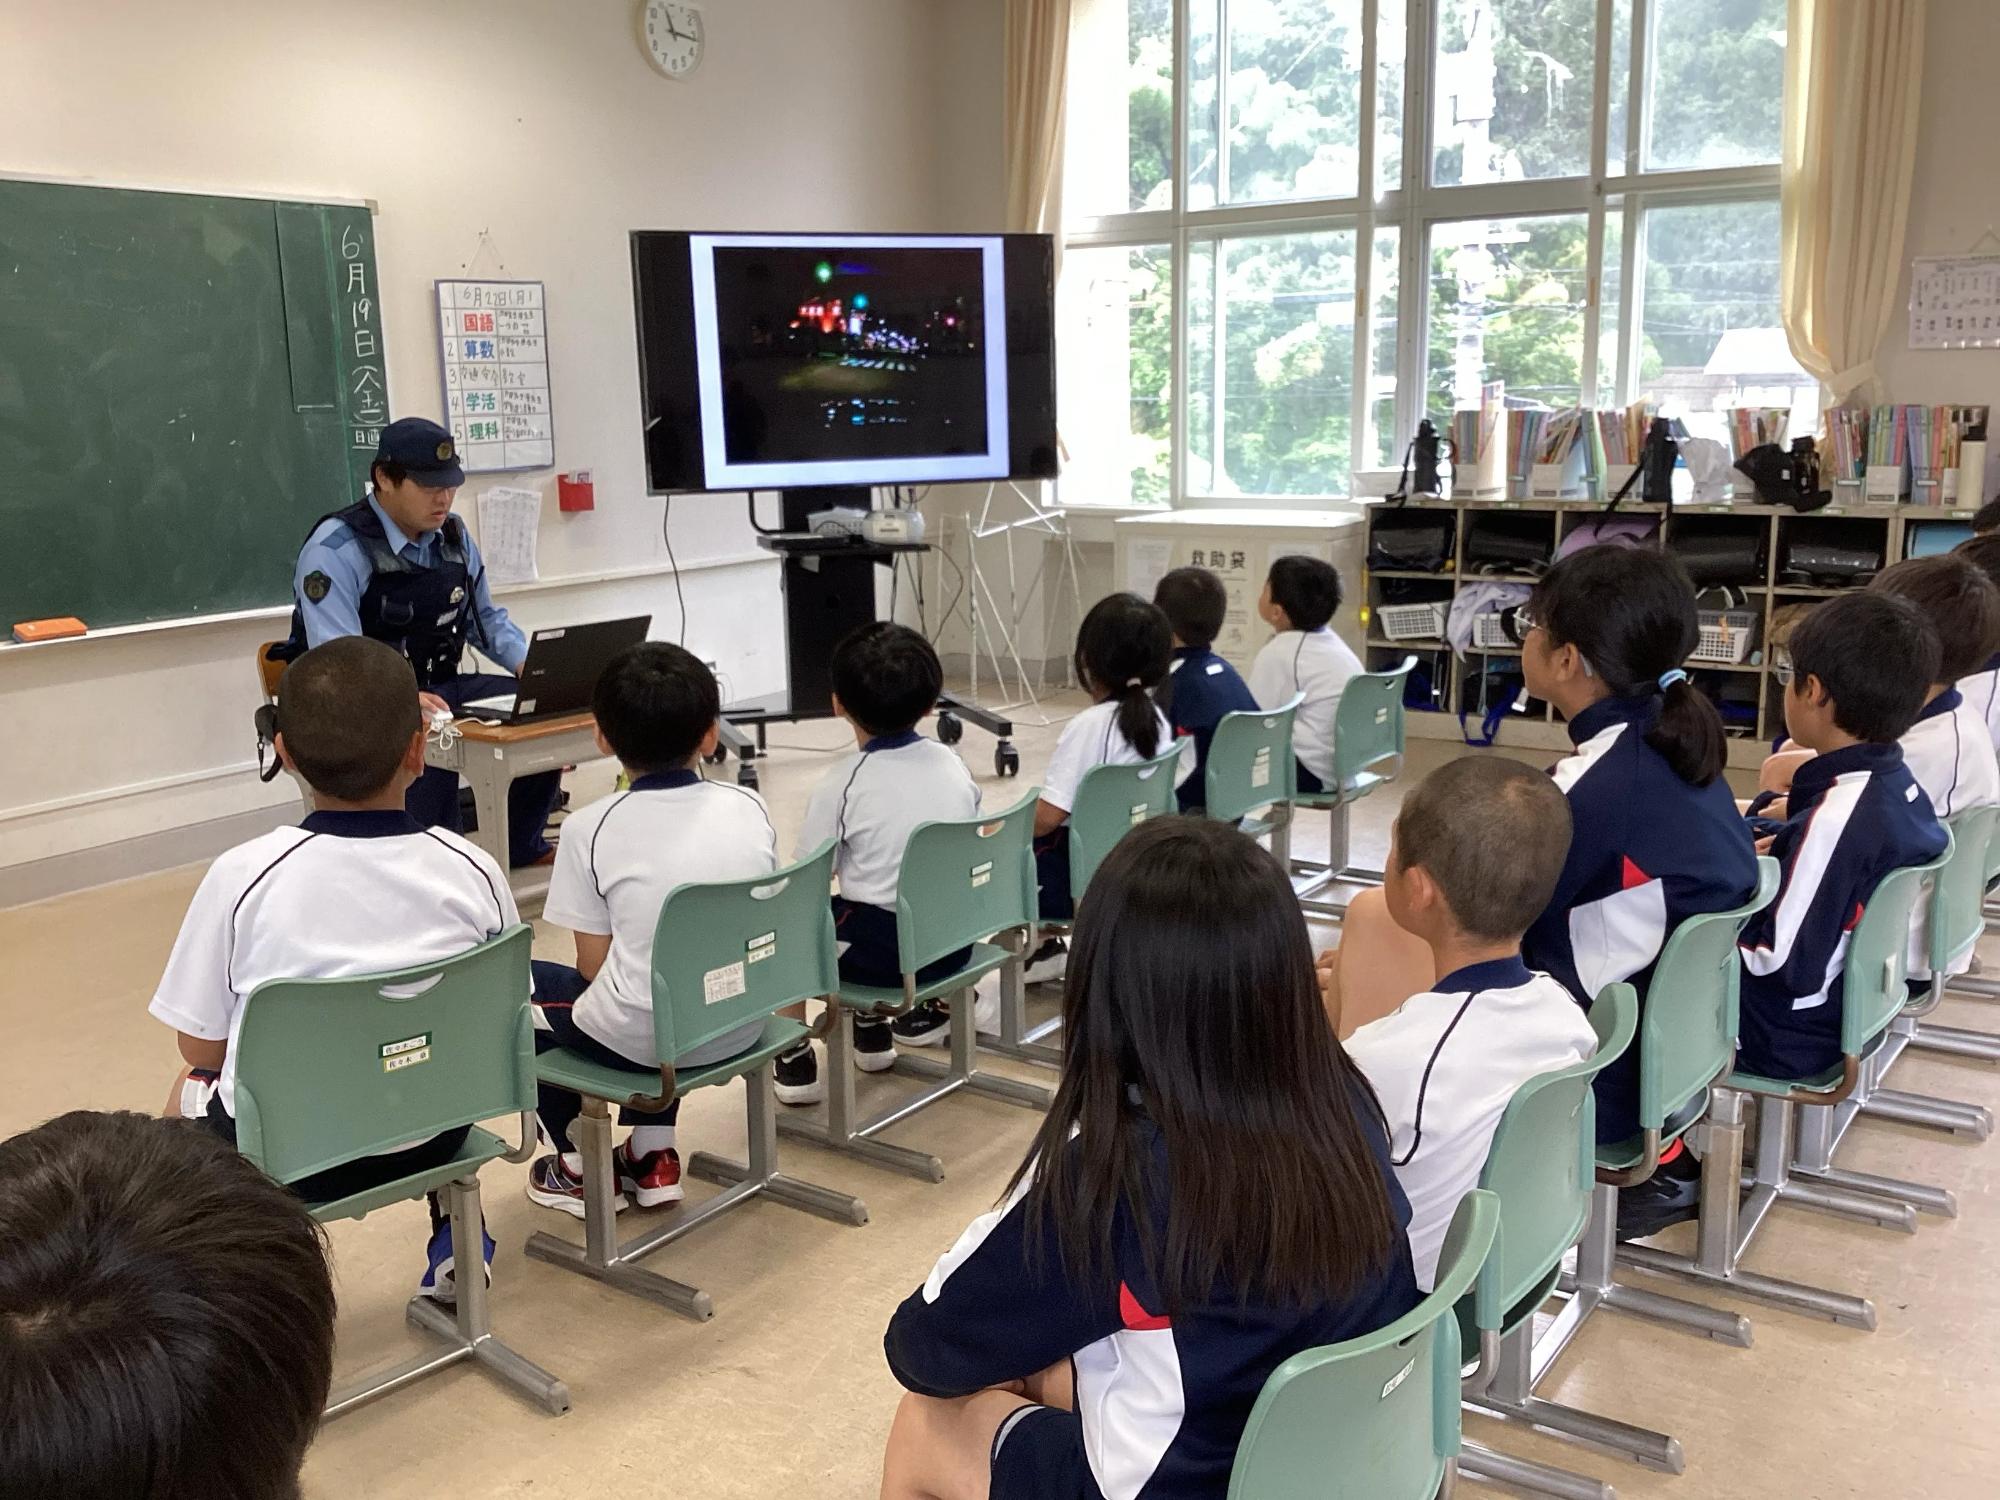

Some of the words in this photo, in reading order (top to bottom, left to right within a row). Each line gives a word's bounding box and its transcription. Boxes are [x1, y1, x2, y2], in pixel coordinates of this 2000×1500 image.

[464, 313, 495, 333] 国語
[447, 342, 454, 357] 2
[464, 339, 496, 360] 算数
[449, 368, 457, 384] 3
[451, 395, 459, 411] 4
[466, 391, 496, 412] 学活
[454, 423, 462, 440] 5
[468, 420, 499, 440] 理科
[1191, 549, 1246, 570] 救助袋
